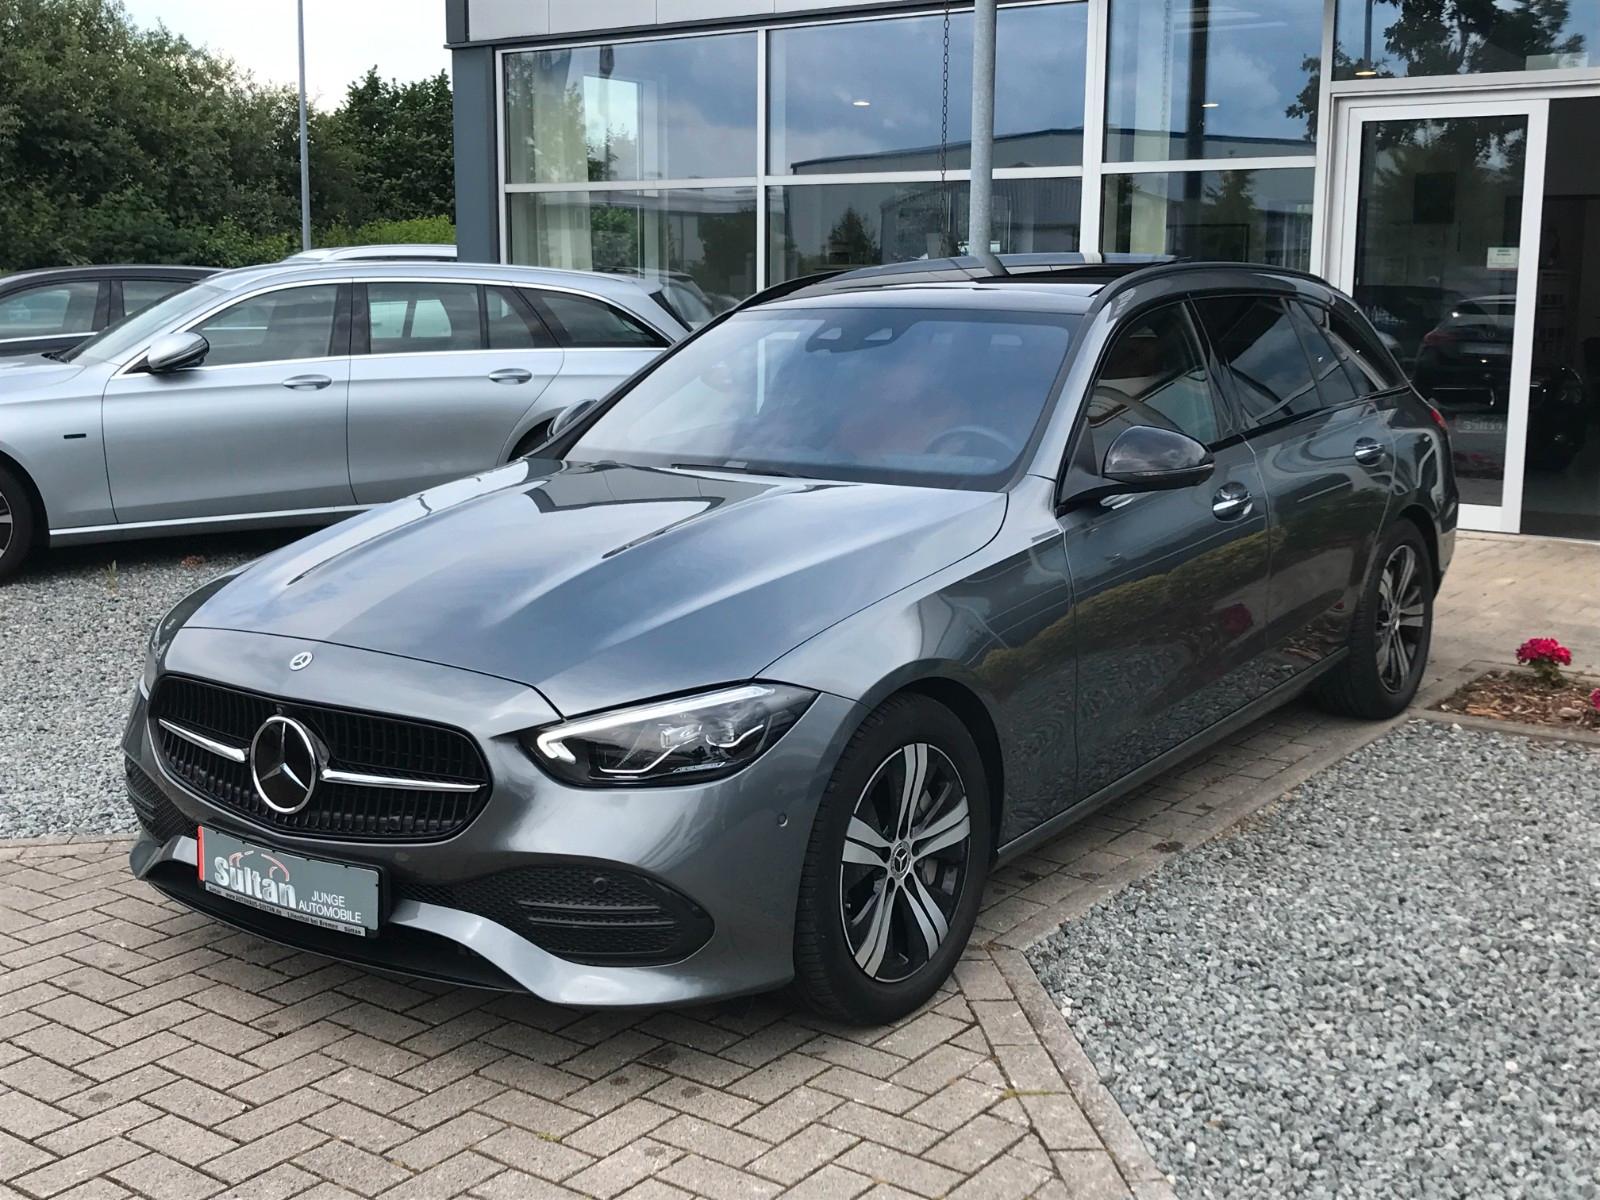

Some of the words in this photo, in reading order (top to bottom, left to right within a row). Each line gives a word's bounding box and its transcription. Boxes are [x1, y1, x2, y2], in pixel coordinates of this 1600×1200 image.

[311, 890, 346, 908] JUNGE
[298, 900, 362, 924] AUTOMOBILE
[319, 919, 339, 930] Bremen
